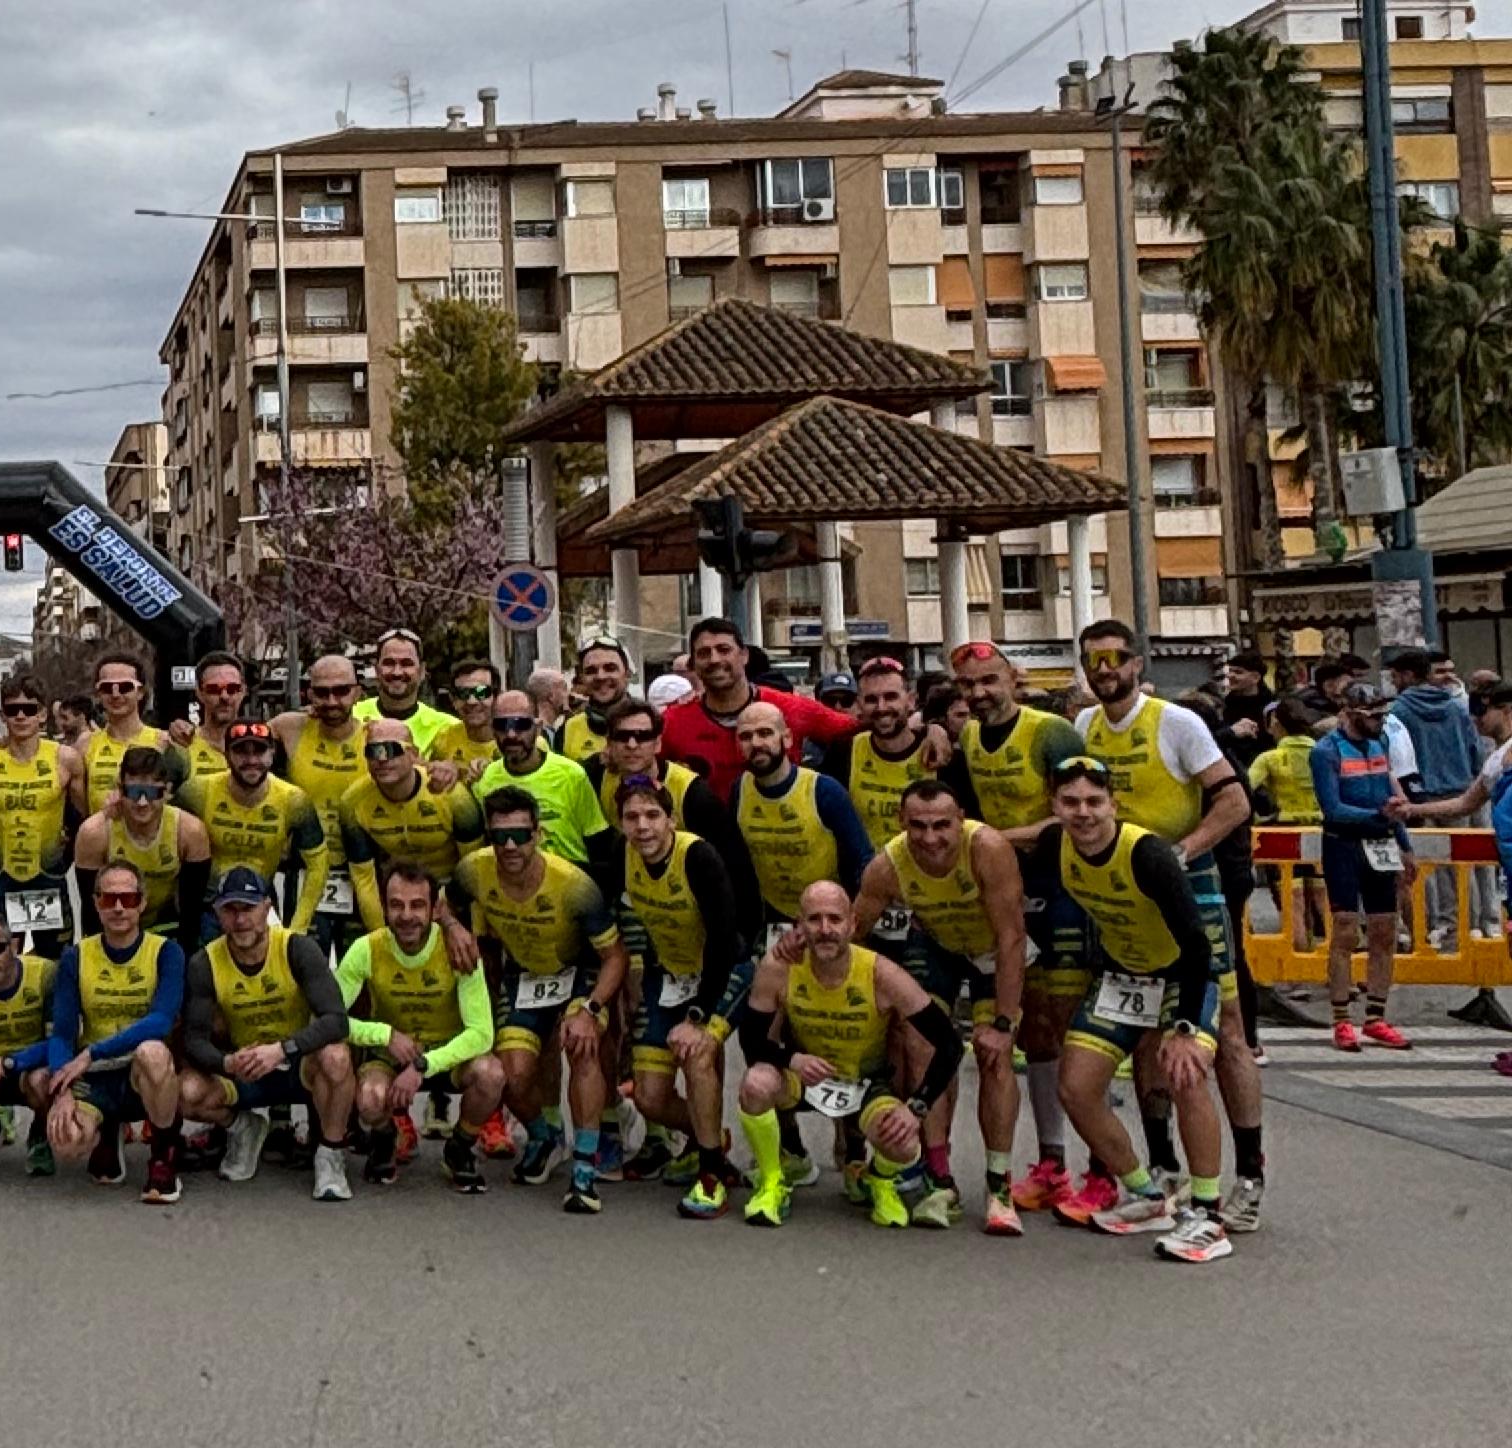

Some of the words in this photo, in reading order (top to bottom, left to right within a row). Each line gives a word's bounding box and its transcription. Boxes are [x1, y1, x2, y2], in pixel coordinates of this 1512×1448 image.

[49, 519, 91, 552] ES
[81, 545, 164, 620] SALUD
[71, 504, 101, 533] EL
[93, 526, 183, 606] DEPORTE
[1119, 990, 1145, 1015] 78
[821, 1086, 849, 1110] 75
